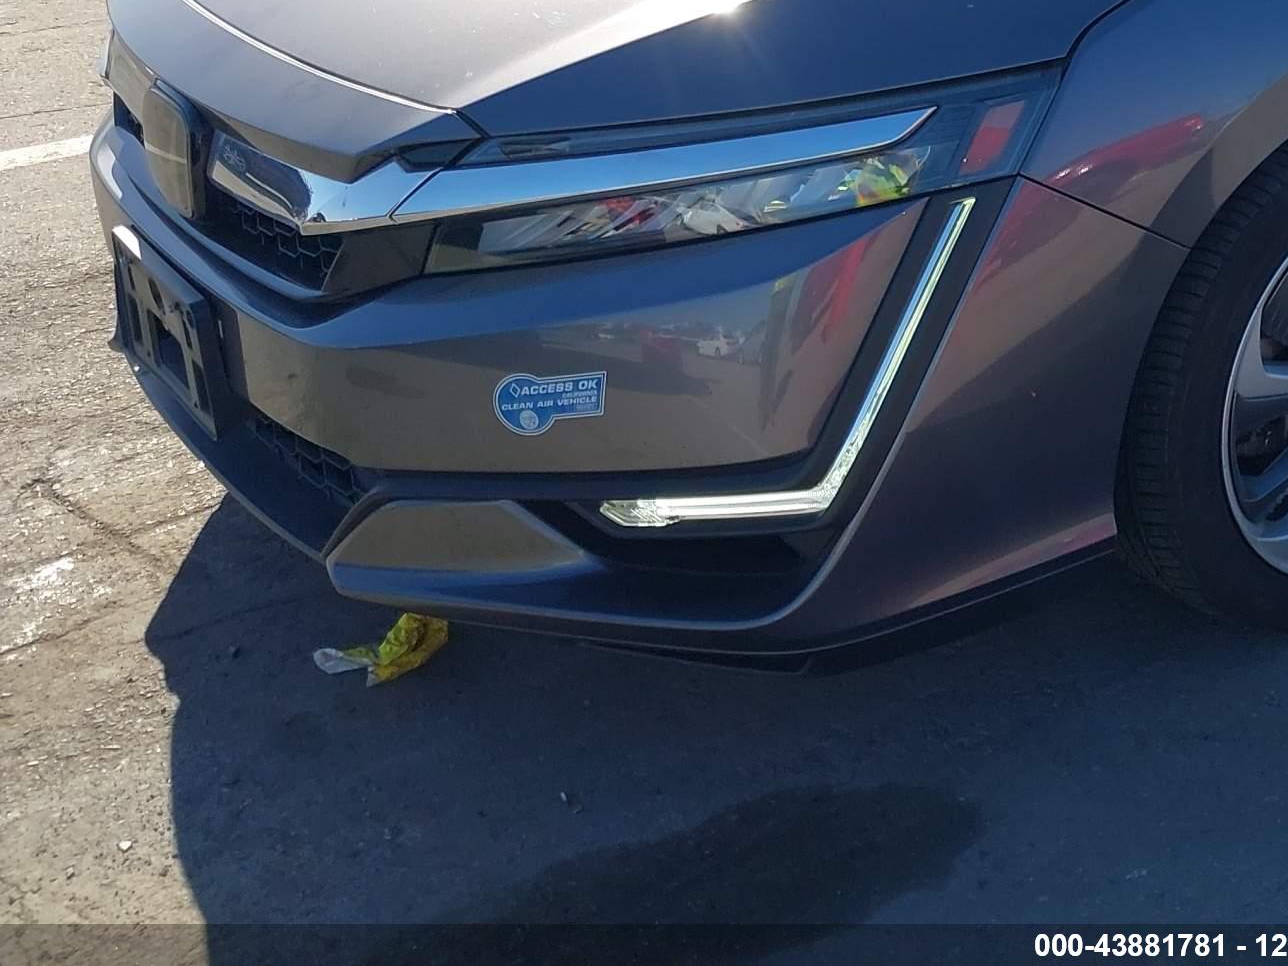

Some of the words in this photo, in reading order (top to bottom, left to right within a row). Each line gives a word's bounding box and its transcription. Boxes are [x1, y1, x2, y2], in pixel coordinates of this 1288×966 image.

[521, 381, 573, 396] ACCESS
[578, 378, 598, 390] OK
[502, 402, 534, 411] CLEAN
[537, 400, 553, 408] AIR
[557, 396, 597, 406] VEHICLE
